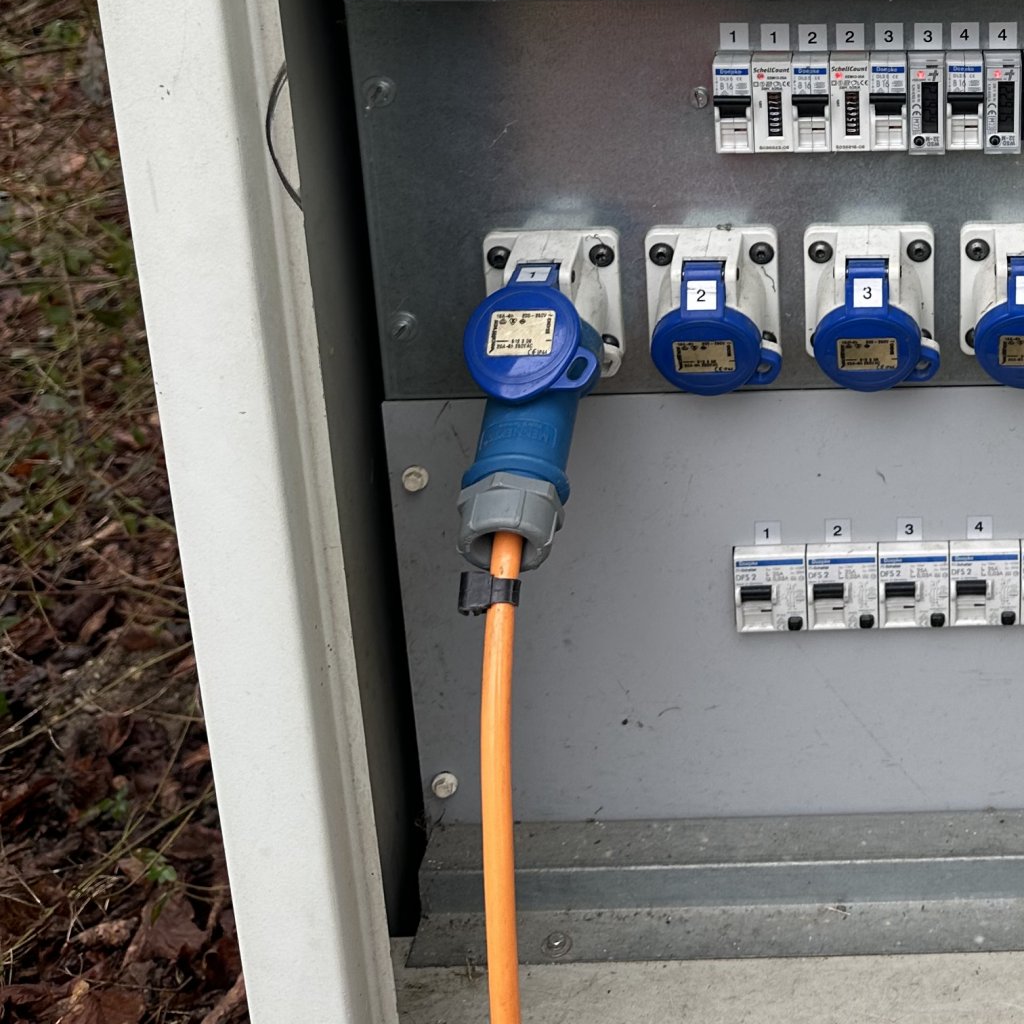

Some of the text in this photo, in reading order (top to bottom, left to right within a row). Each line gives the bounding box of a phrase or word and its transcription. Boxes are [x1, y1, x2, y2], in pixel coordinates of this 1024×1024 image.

[807, 31, 817, 45] 2
[845, 30, 855, 43] 2
[883, 29, 894, 43] 3
[923, 29, 933, 43] 3
[959, 28, 970, 41] 4
[997, 28, 1008, 41] 4
[696, 289, 706, 303] 2
[863, 286, 873, 300] 3
[833, 525, 842, 537] 2
[904, 523, 914, 535] 3
[974, 521, 984, 532] 4
